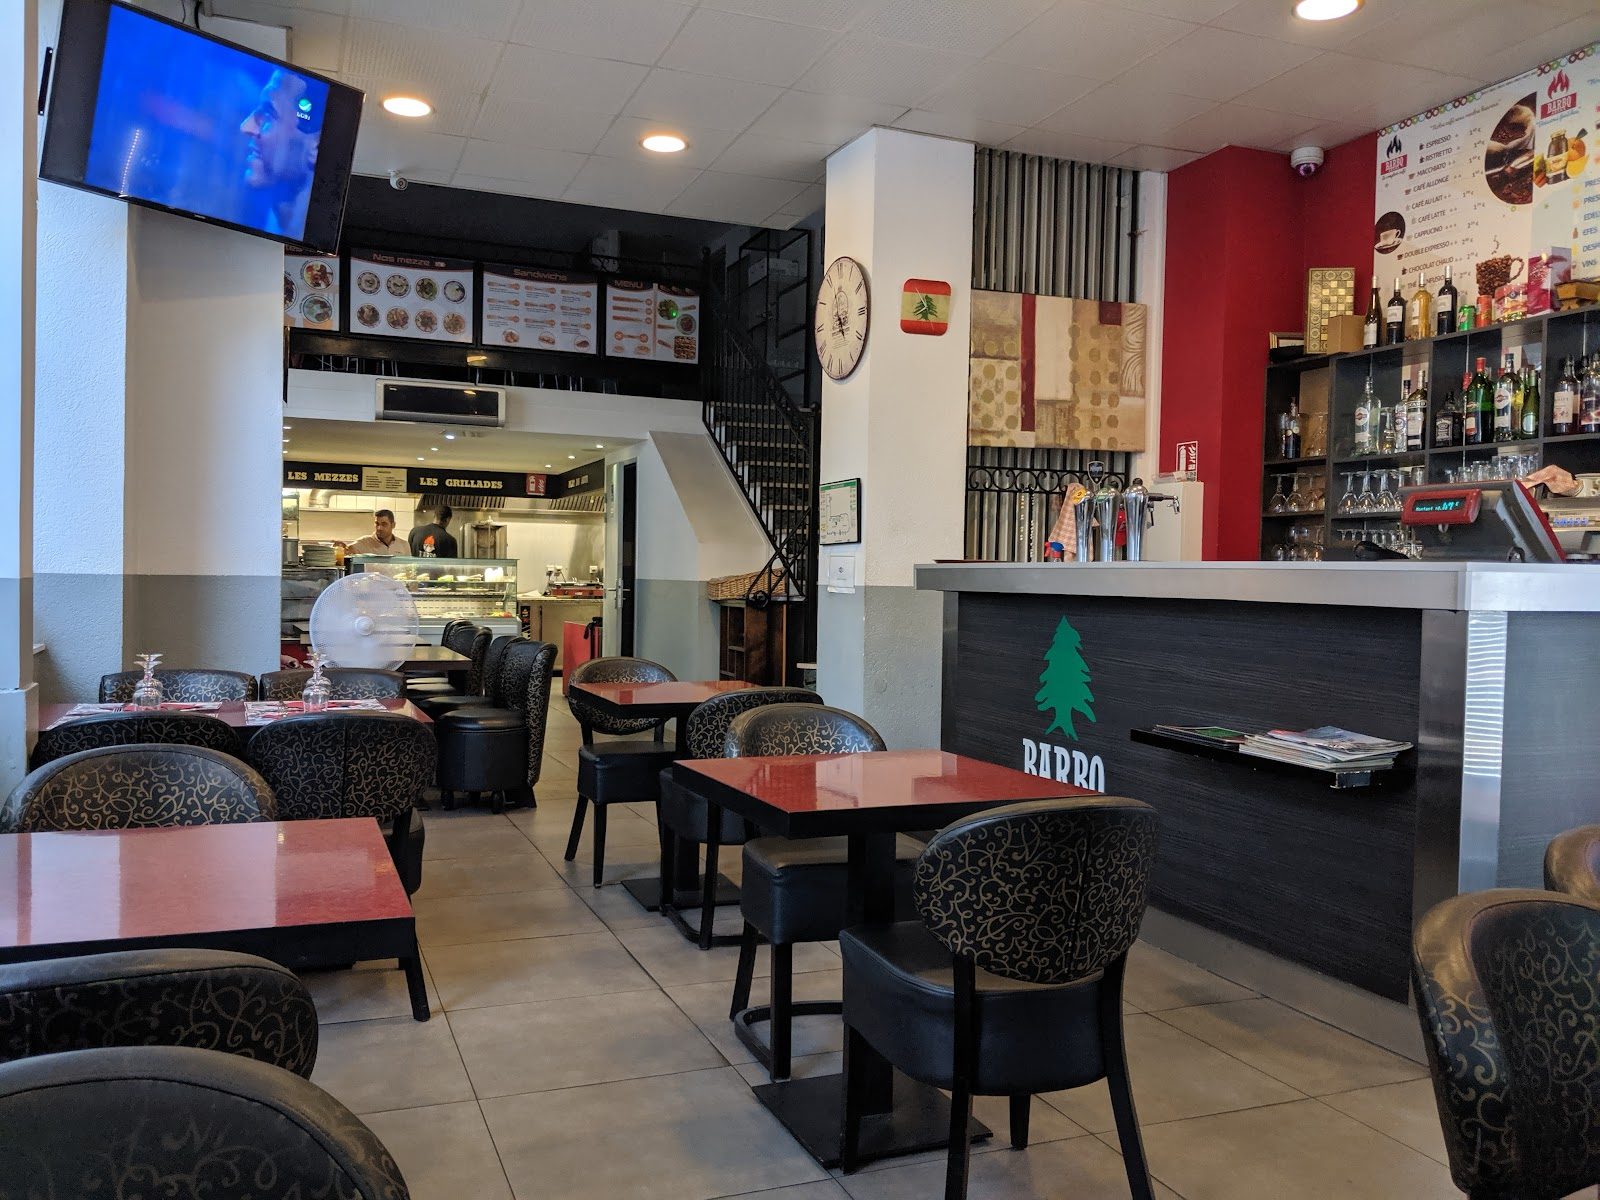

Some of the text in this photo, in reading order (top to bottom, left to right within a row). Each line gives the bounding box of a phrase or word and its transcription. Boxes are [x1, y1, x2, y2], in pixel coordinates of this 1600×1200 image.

[1425, 147, 1453, 162] RISTRETTO
[287, 471, 308, 481] LES
[314, 472, 359, 483] MEZZES
[419, 477, 503, 490] LES GRILLADES
